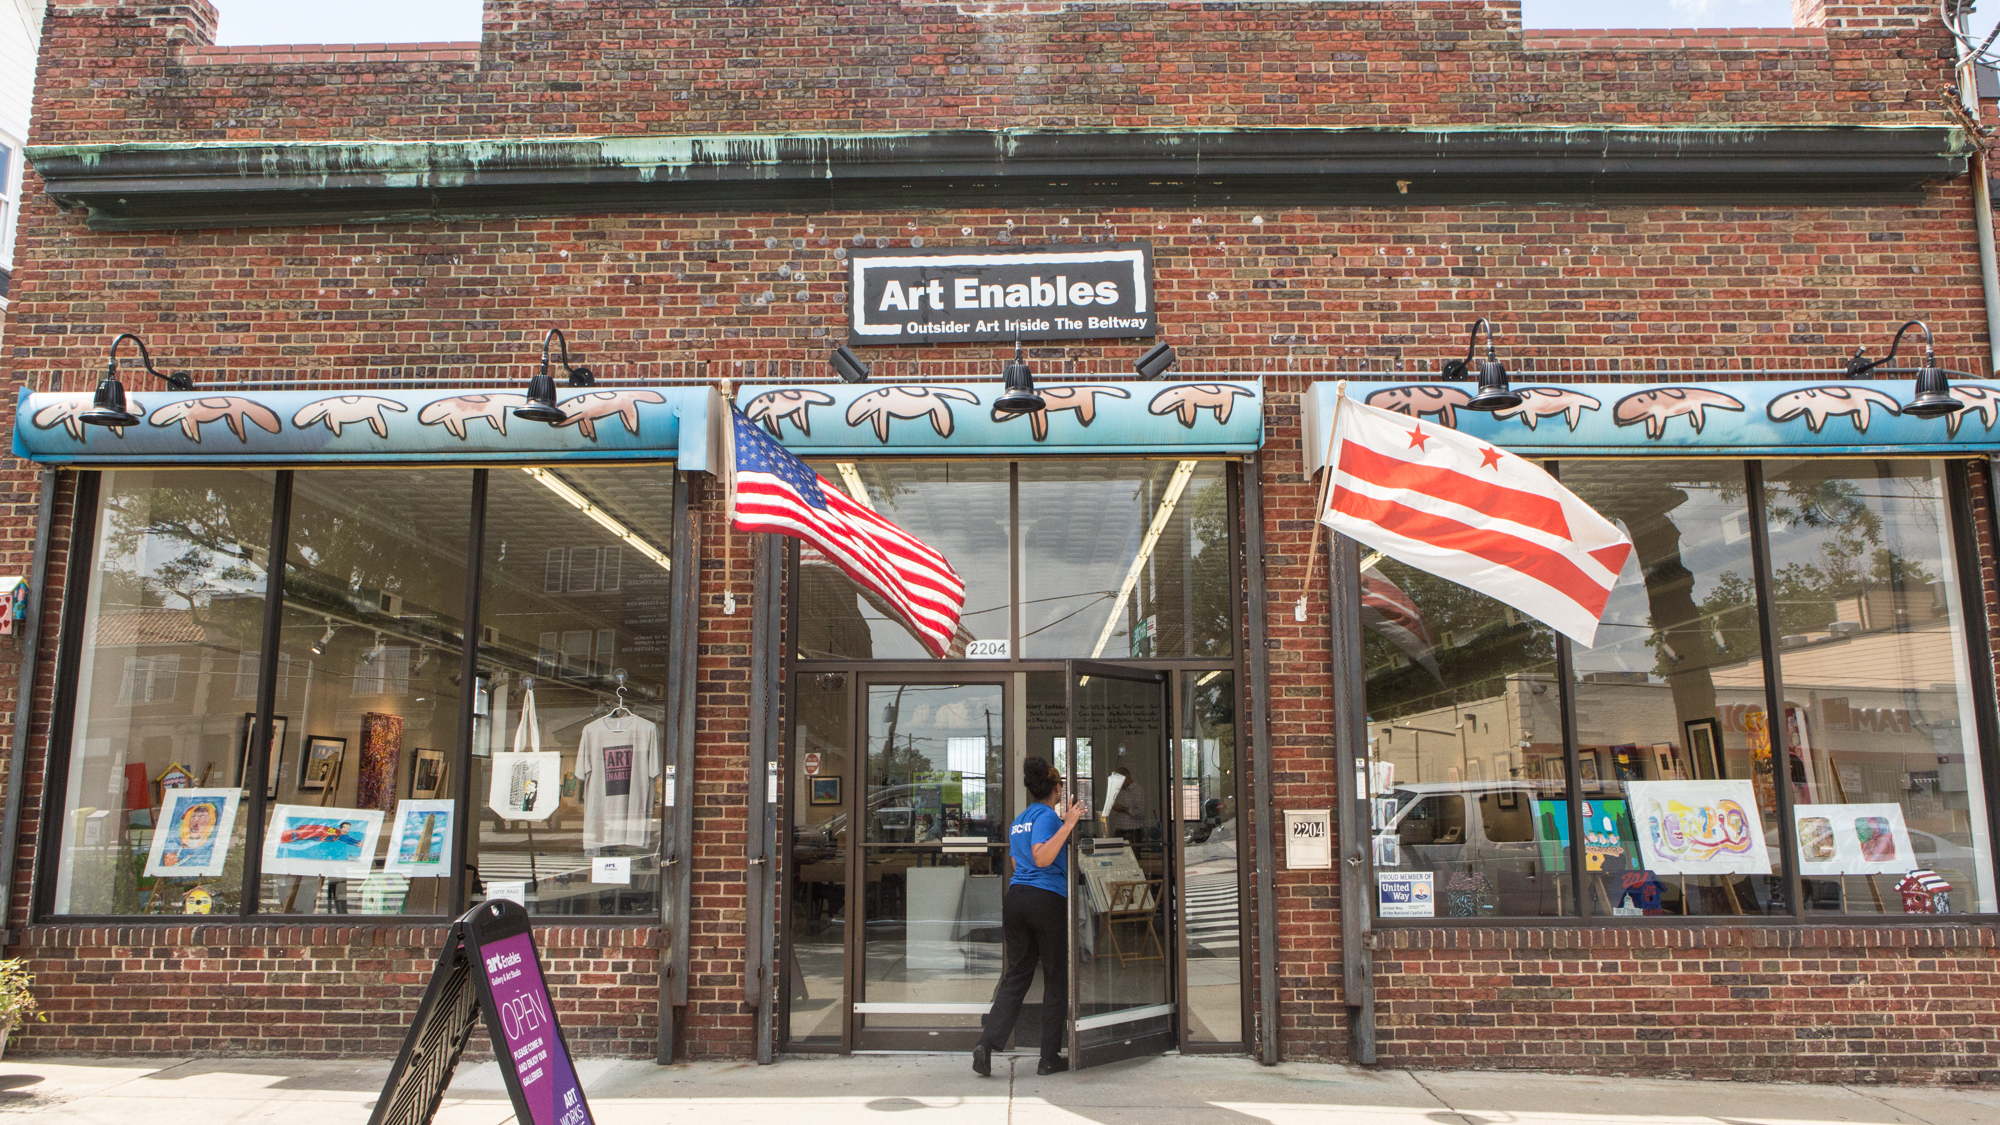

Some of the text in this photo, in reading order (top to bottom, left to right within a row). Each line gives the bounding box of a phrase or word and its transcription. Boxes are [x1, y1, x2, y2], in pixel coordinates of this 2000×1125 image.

[878, 275, 1119, 311] Art Enables
[906, 315, 1147, 335] Outsider Art Inside The Beltway
[970, 642, 1007, 655] 2204
[607, 750, 630, 767] ART
[1294, 822, 1324, 837] 2204
[1382, 883, 1410, 892] United
[1393, 892, 1410, 902] Way
[486, 952, 521, 973] art Enables
[502, 989, 547, 1040] OPEN
[514, 1037, 544, 1060] PLEASE COME IN
[518, 1050, 548, 1074] AND ENJOY OUR
[564, 1087, 578, 1109] ART
